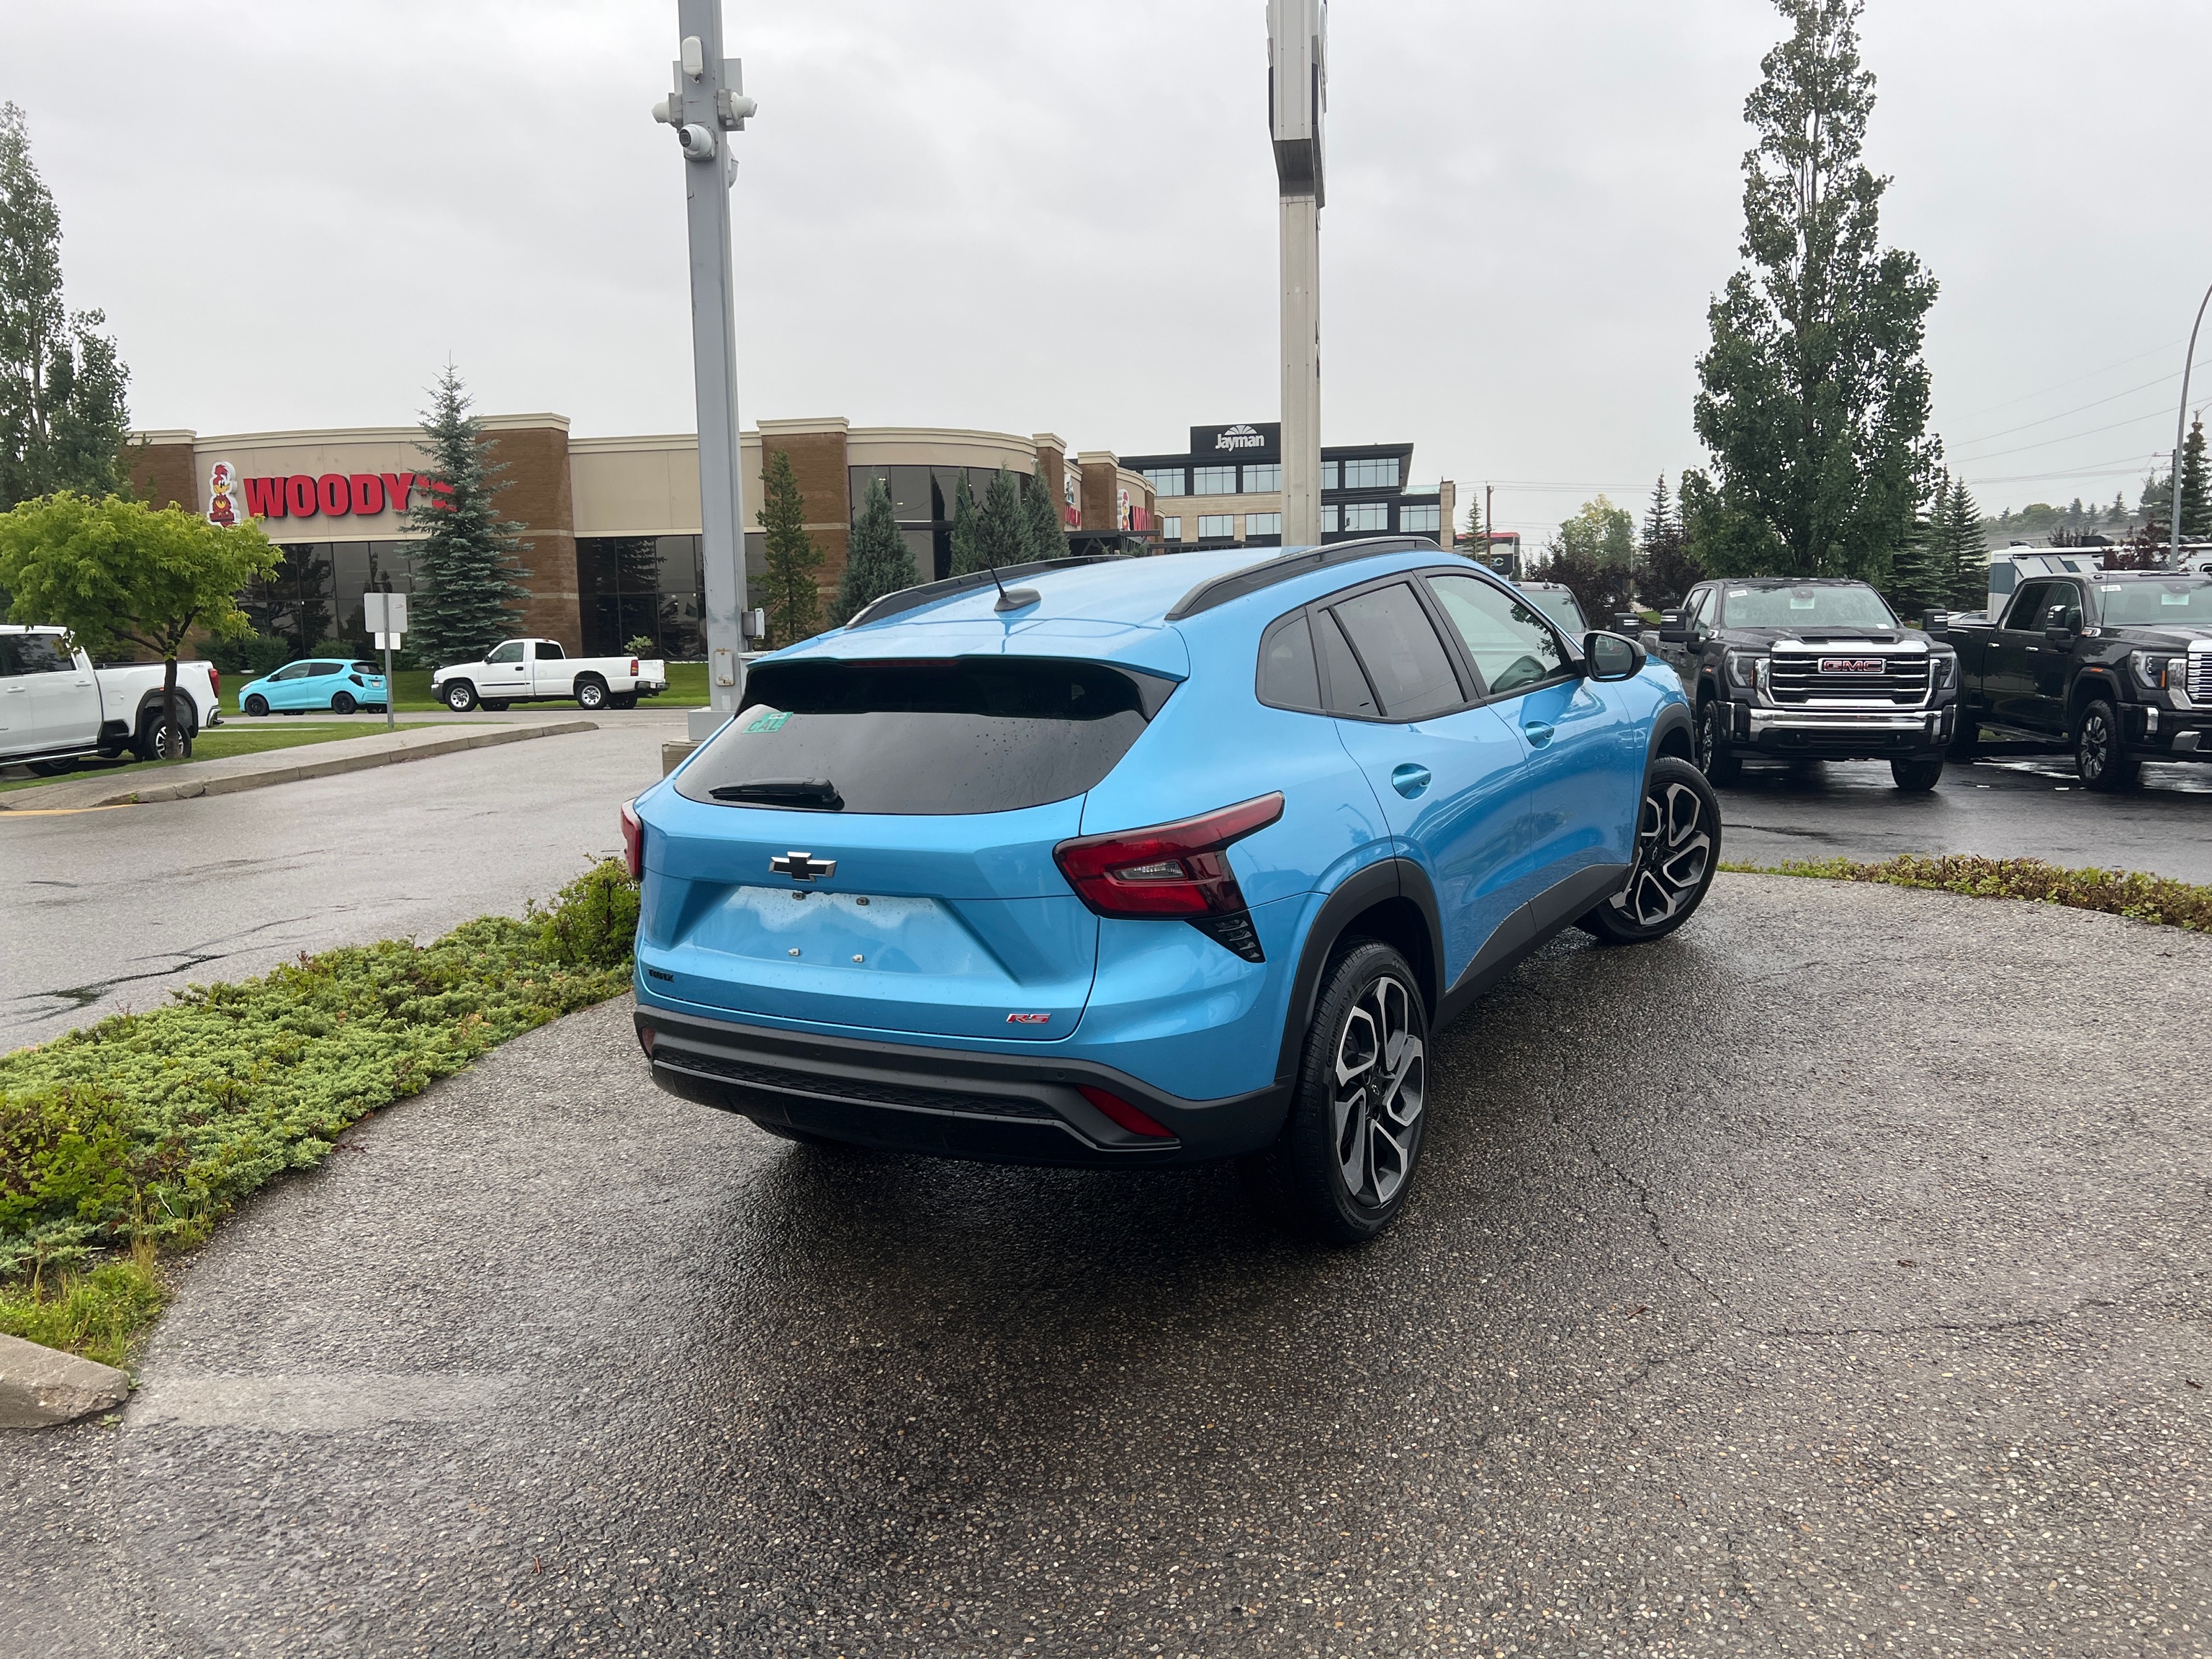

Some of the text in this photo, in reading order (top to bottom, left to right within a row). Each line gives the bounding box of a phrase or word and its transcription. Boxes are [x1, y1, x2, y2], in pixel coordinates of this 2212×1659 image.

[1215, 433, 1264, 451] Jayman
[1823, 660, 1883, 672] GMC
[748, 719, 778, 732] CAL
[1006, 1013, 1051, 1024] RS
